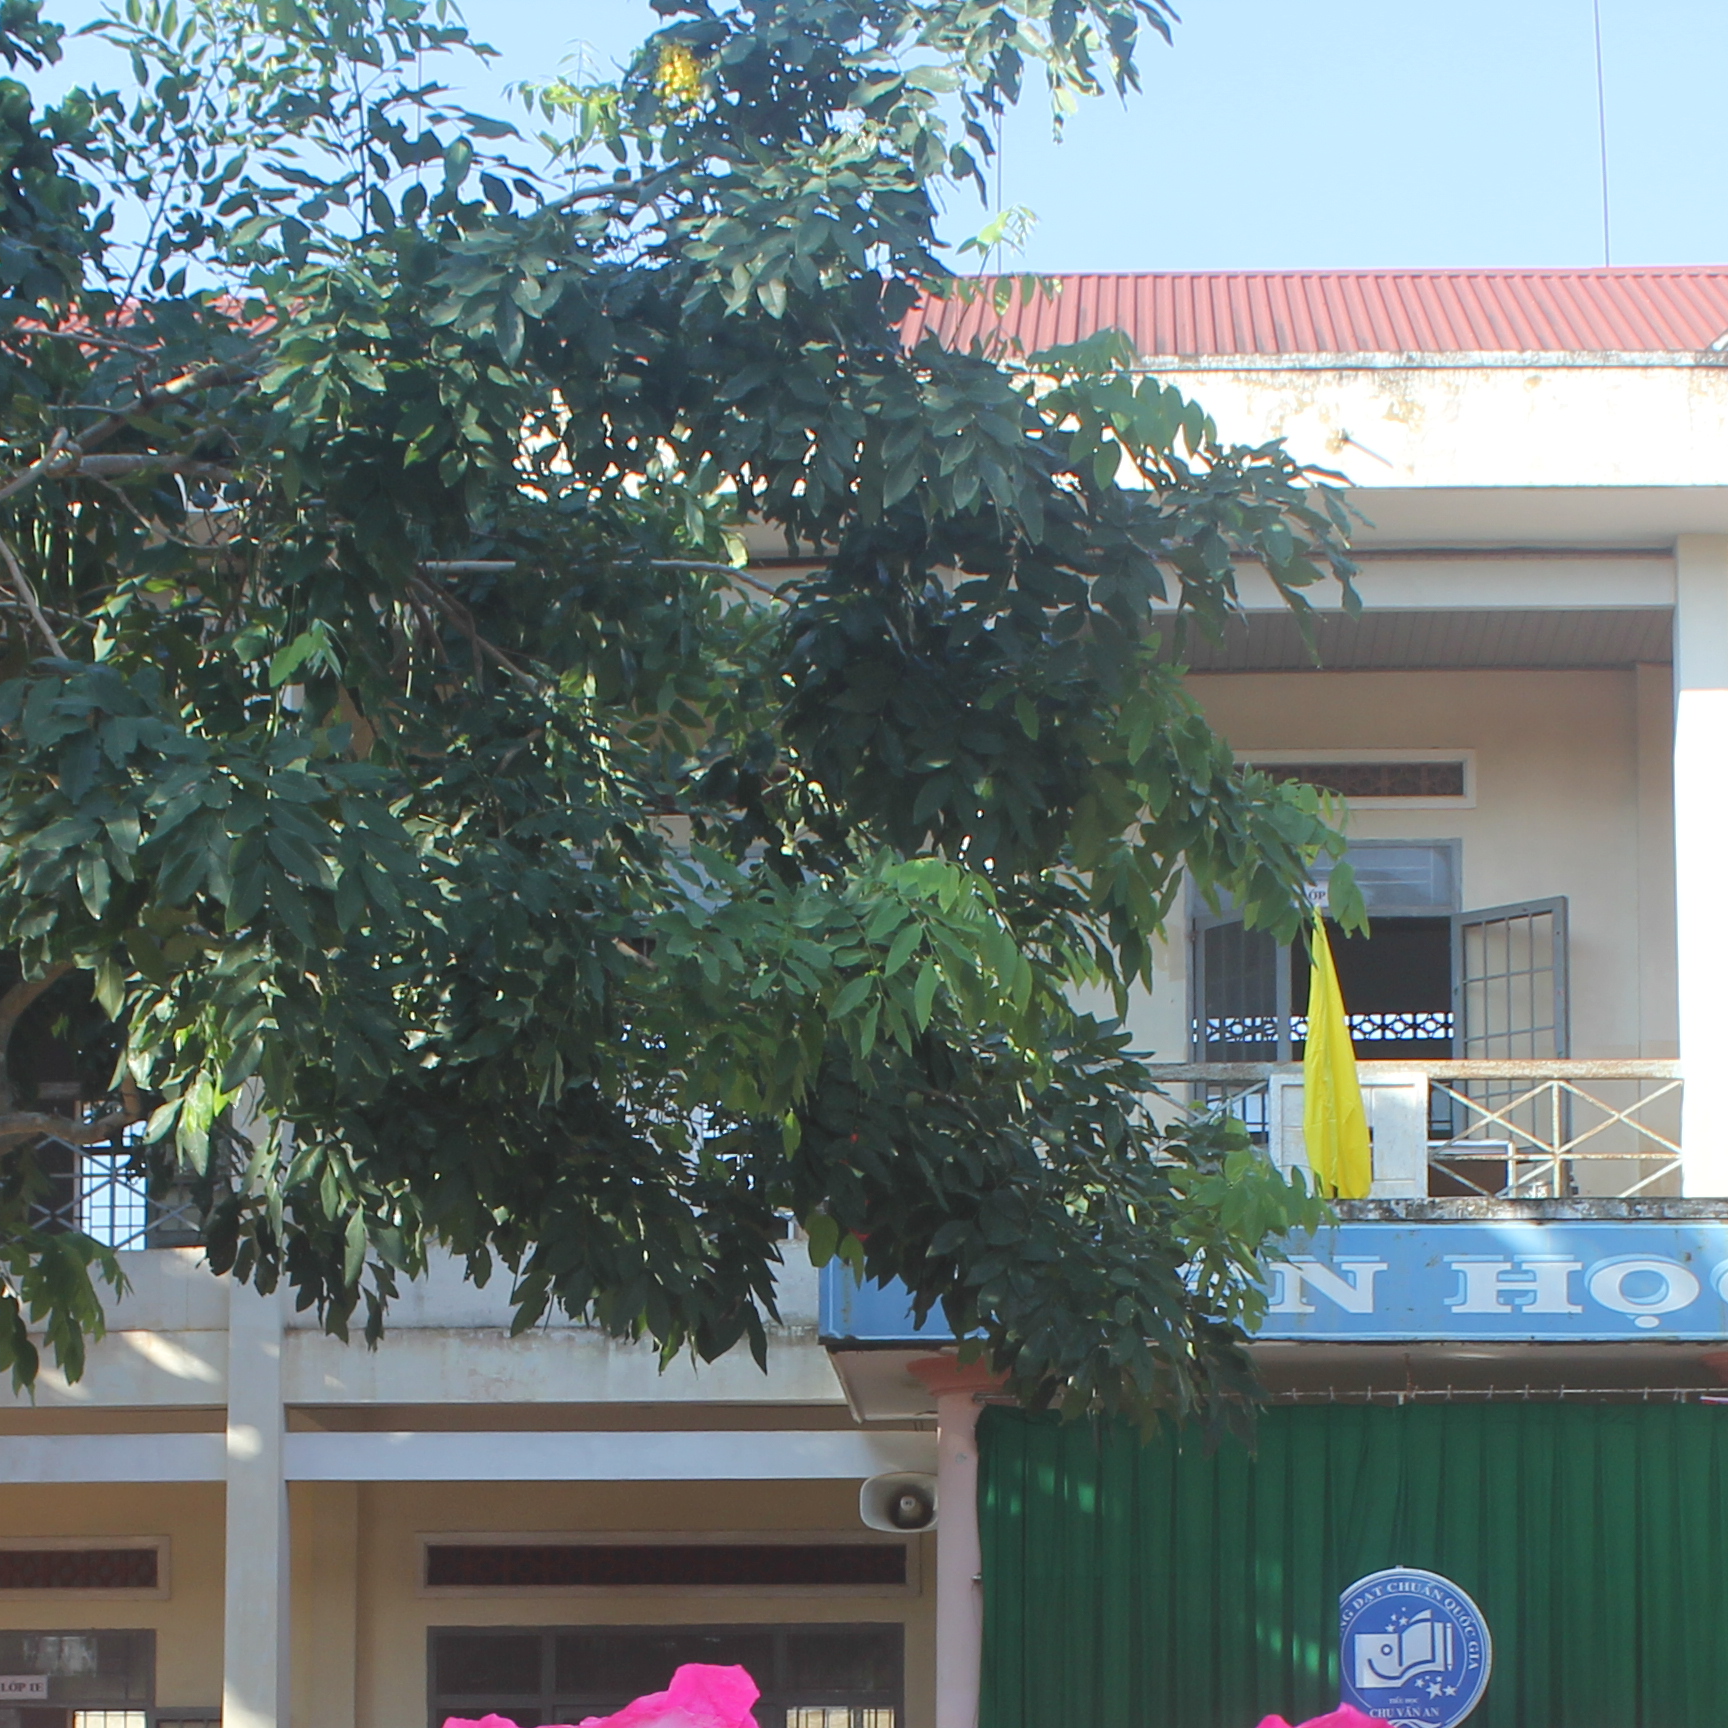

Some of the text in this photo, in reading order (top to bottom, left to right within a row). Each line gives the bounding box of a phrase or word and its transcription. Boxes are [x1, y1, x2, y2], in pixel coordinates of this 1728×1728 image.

[1444, 1597, 1476, 1638] QUỐC
[1468, 1640, 1480, 1670] GIA
[1369, 1706, 1440, 1718] CHU VĂN AN
